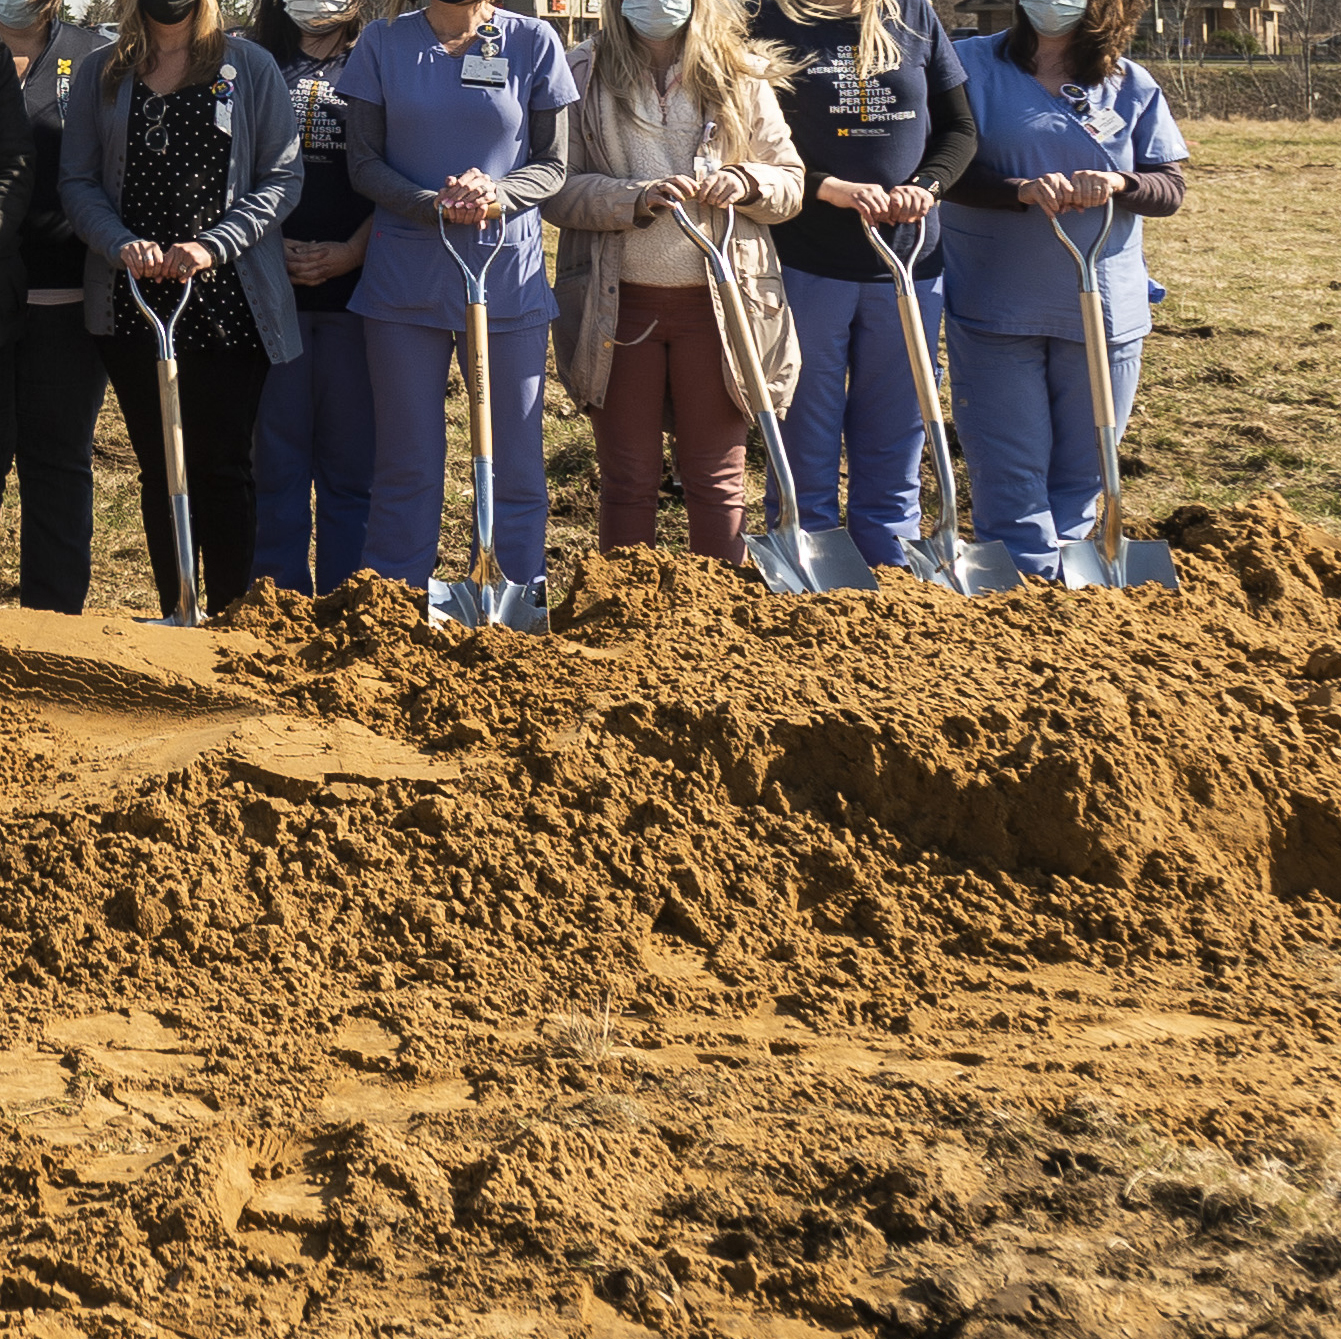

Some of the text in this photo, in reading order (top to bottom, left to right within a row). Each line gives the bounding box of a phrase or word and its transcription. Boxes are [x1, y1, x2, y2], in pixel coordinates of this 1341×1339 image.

[832, 80, 879, 89] TETANUS
[839, 88, 892, 97] HEPATITIS
[839, 96, 896, 105] PERTUSSIS
[829, 105, 888, 114] INFLUENZA
[299, 125, 342, 134] RTUSSIS
[837, 128, 850, 136] M
